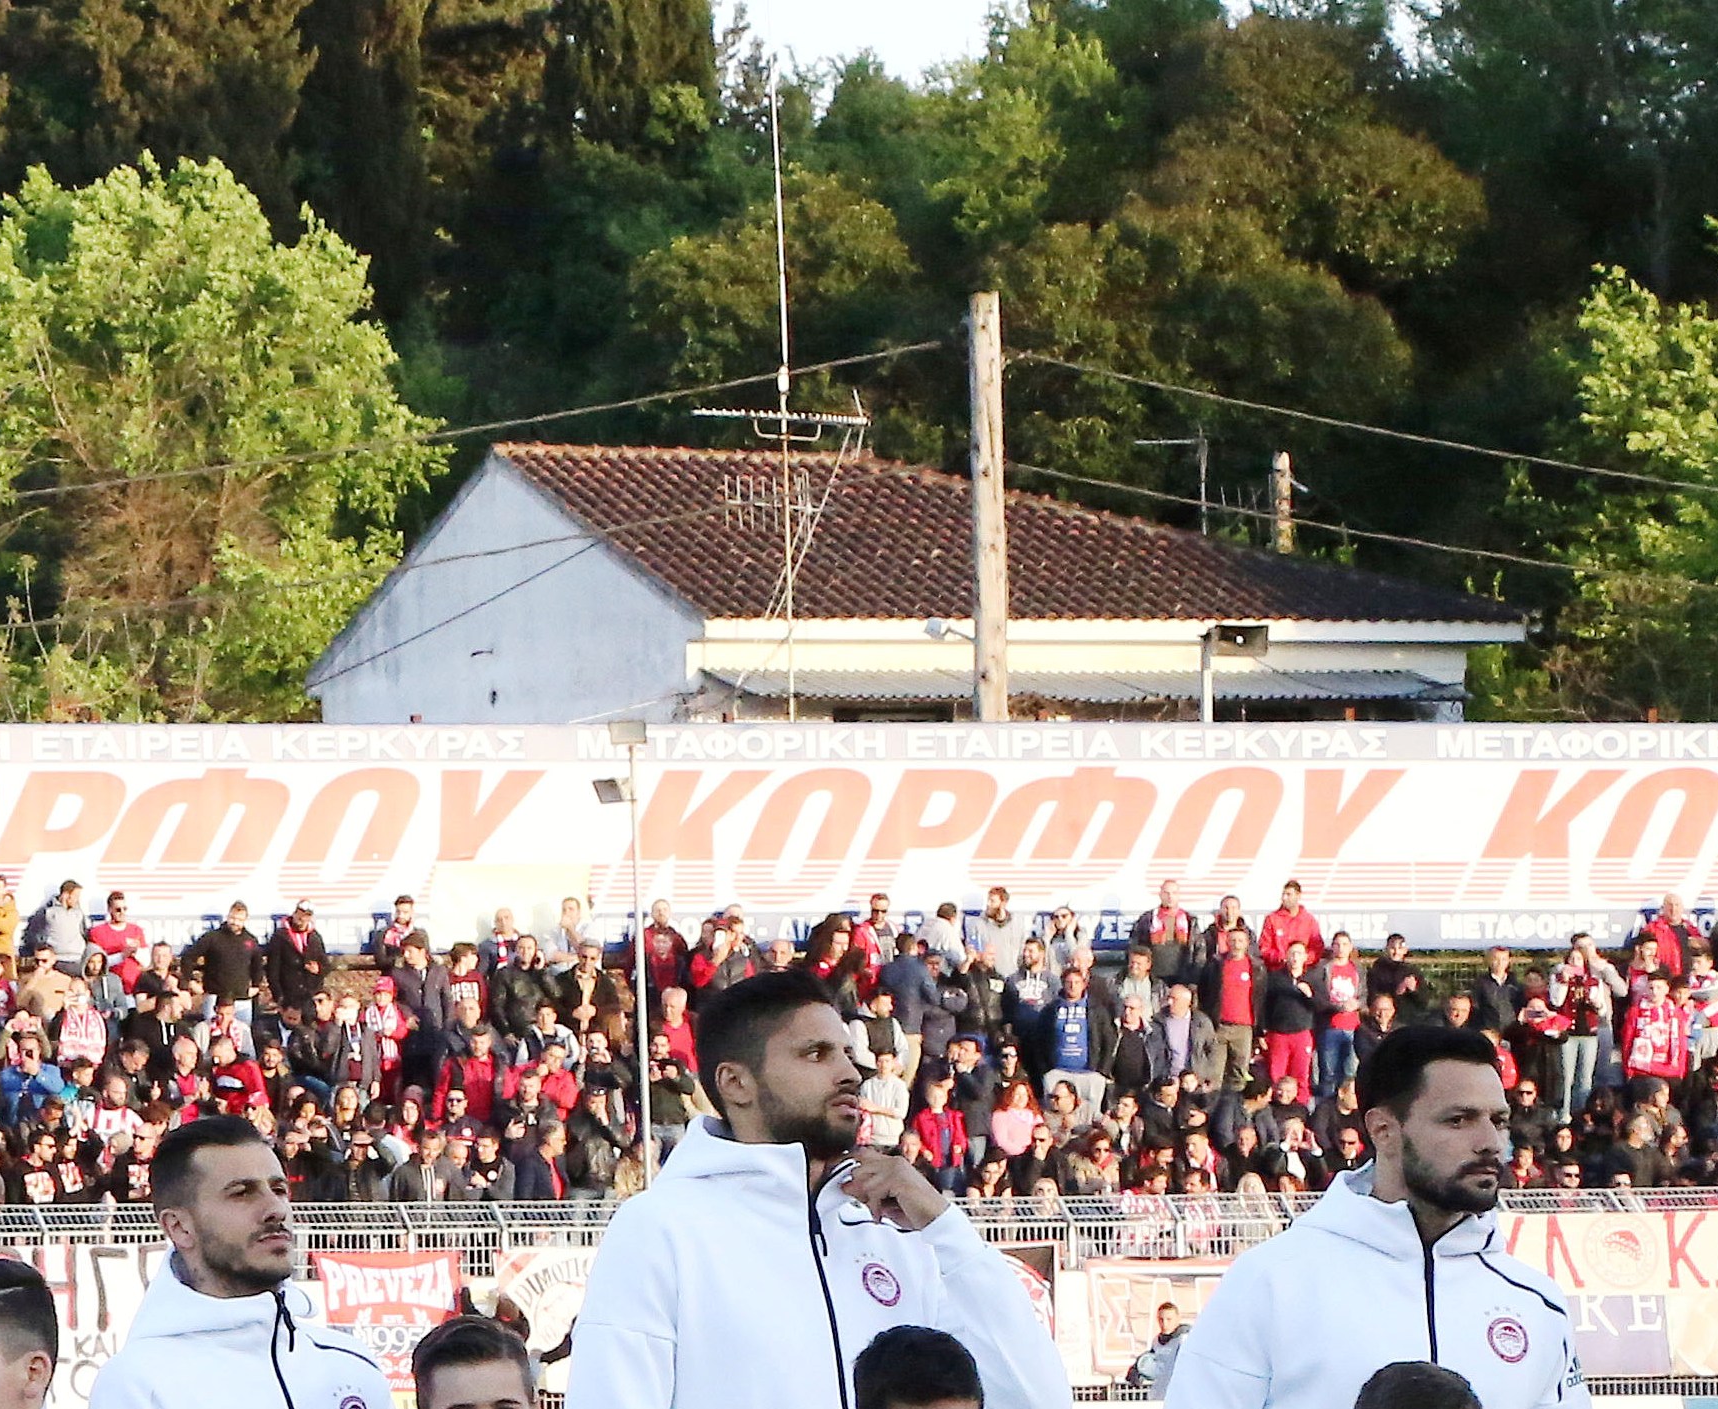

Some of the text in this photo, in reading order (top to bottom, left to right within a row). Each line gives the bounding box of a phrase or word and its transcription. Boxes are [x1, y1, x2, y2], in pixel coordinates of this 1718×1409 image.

[32, 729, 249, 762] ΕΤΑΙΡΕΙΑ
[271, 728, 528, 761] ΚΕΡΚΥΡΑΣ
[906, 728, 1121, 760] ΕΤΑΙΡΕΙΑ
[1139, 727, 1387, 760] ΚΕΡΚΥΡΑΣ
[319, 1255, 457, 1313] PREVEZA
